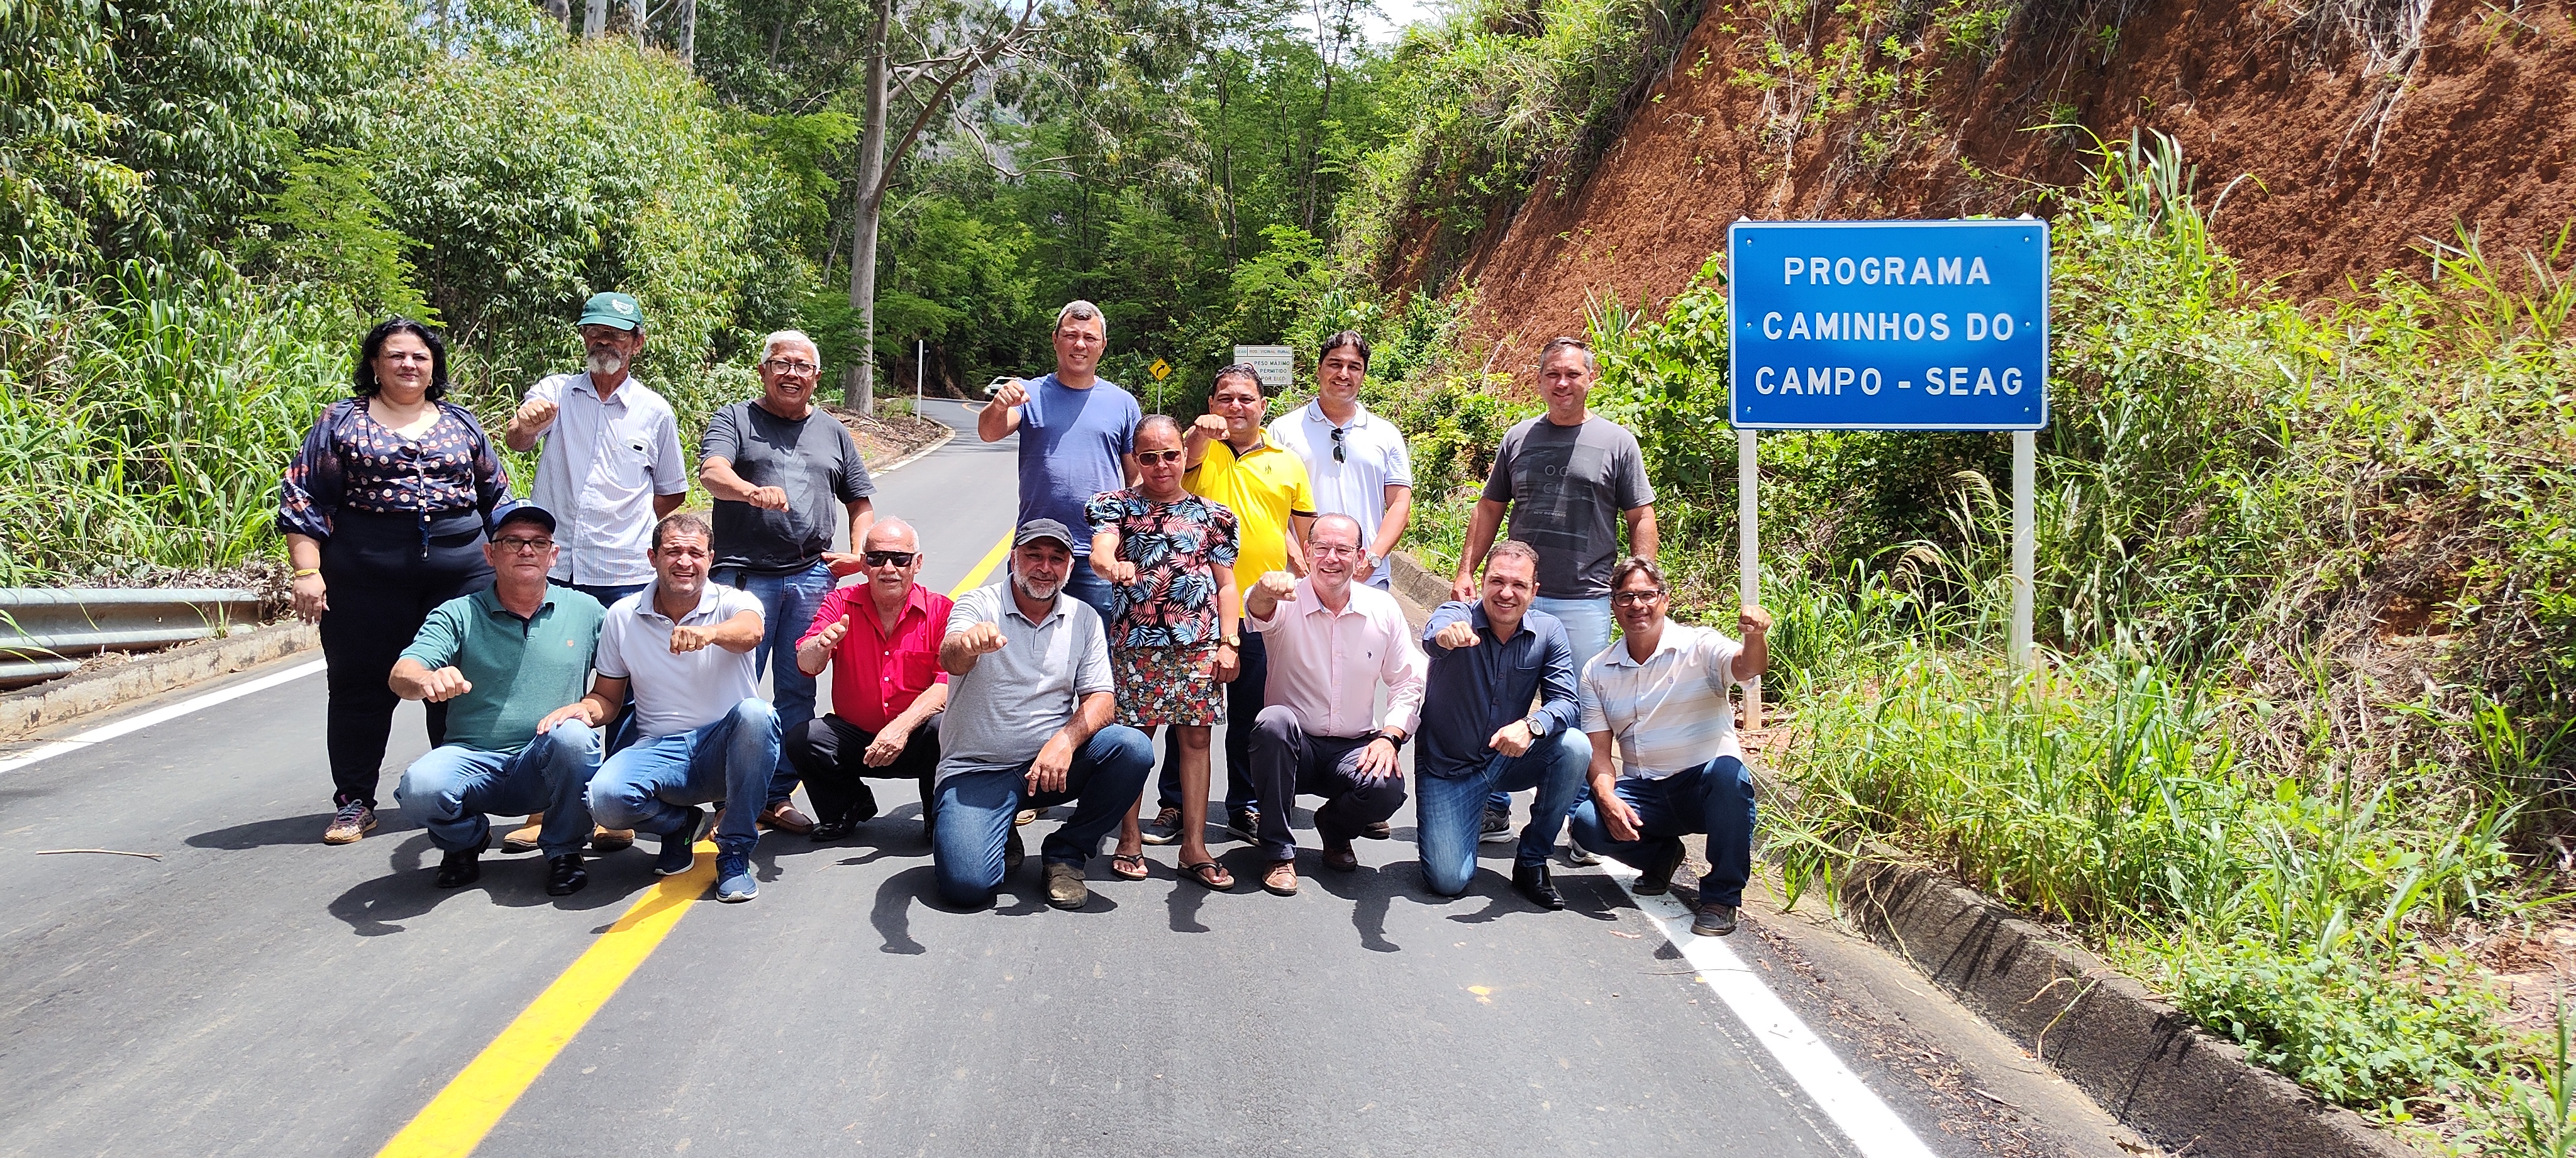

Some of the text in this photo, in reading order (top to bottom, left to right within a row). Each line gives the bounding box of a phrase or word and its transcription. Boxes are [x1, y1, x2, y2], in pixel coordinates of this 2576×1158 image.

[1784, 256, 1990, 285] PROGRAMA
[1762, 311, 2014, 341] CAMINHOS DO
[1755, 367, 2023, 395] CAMPO - SEAG
